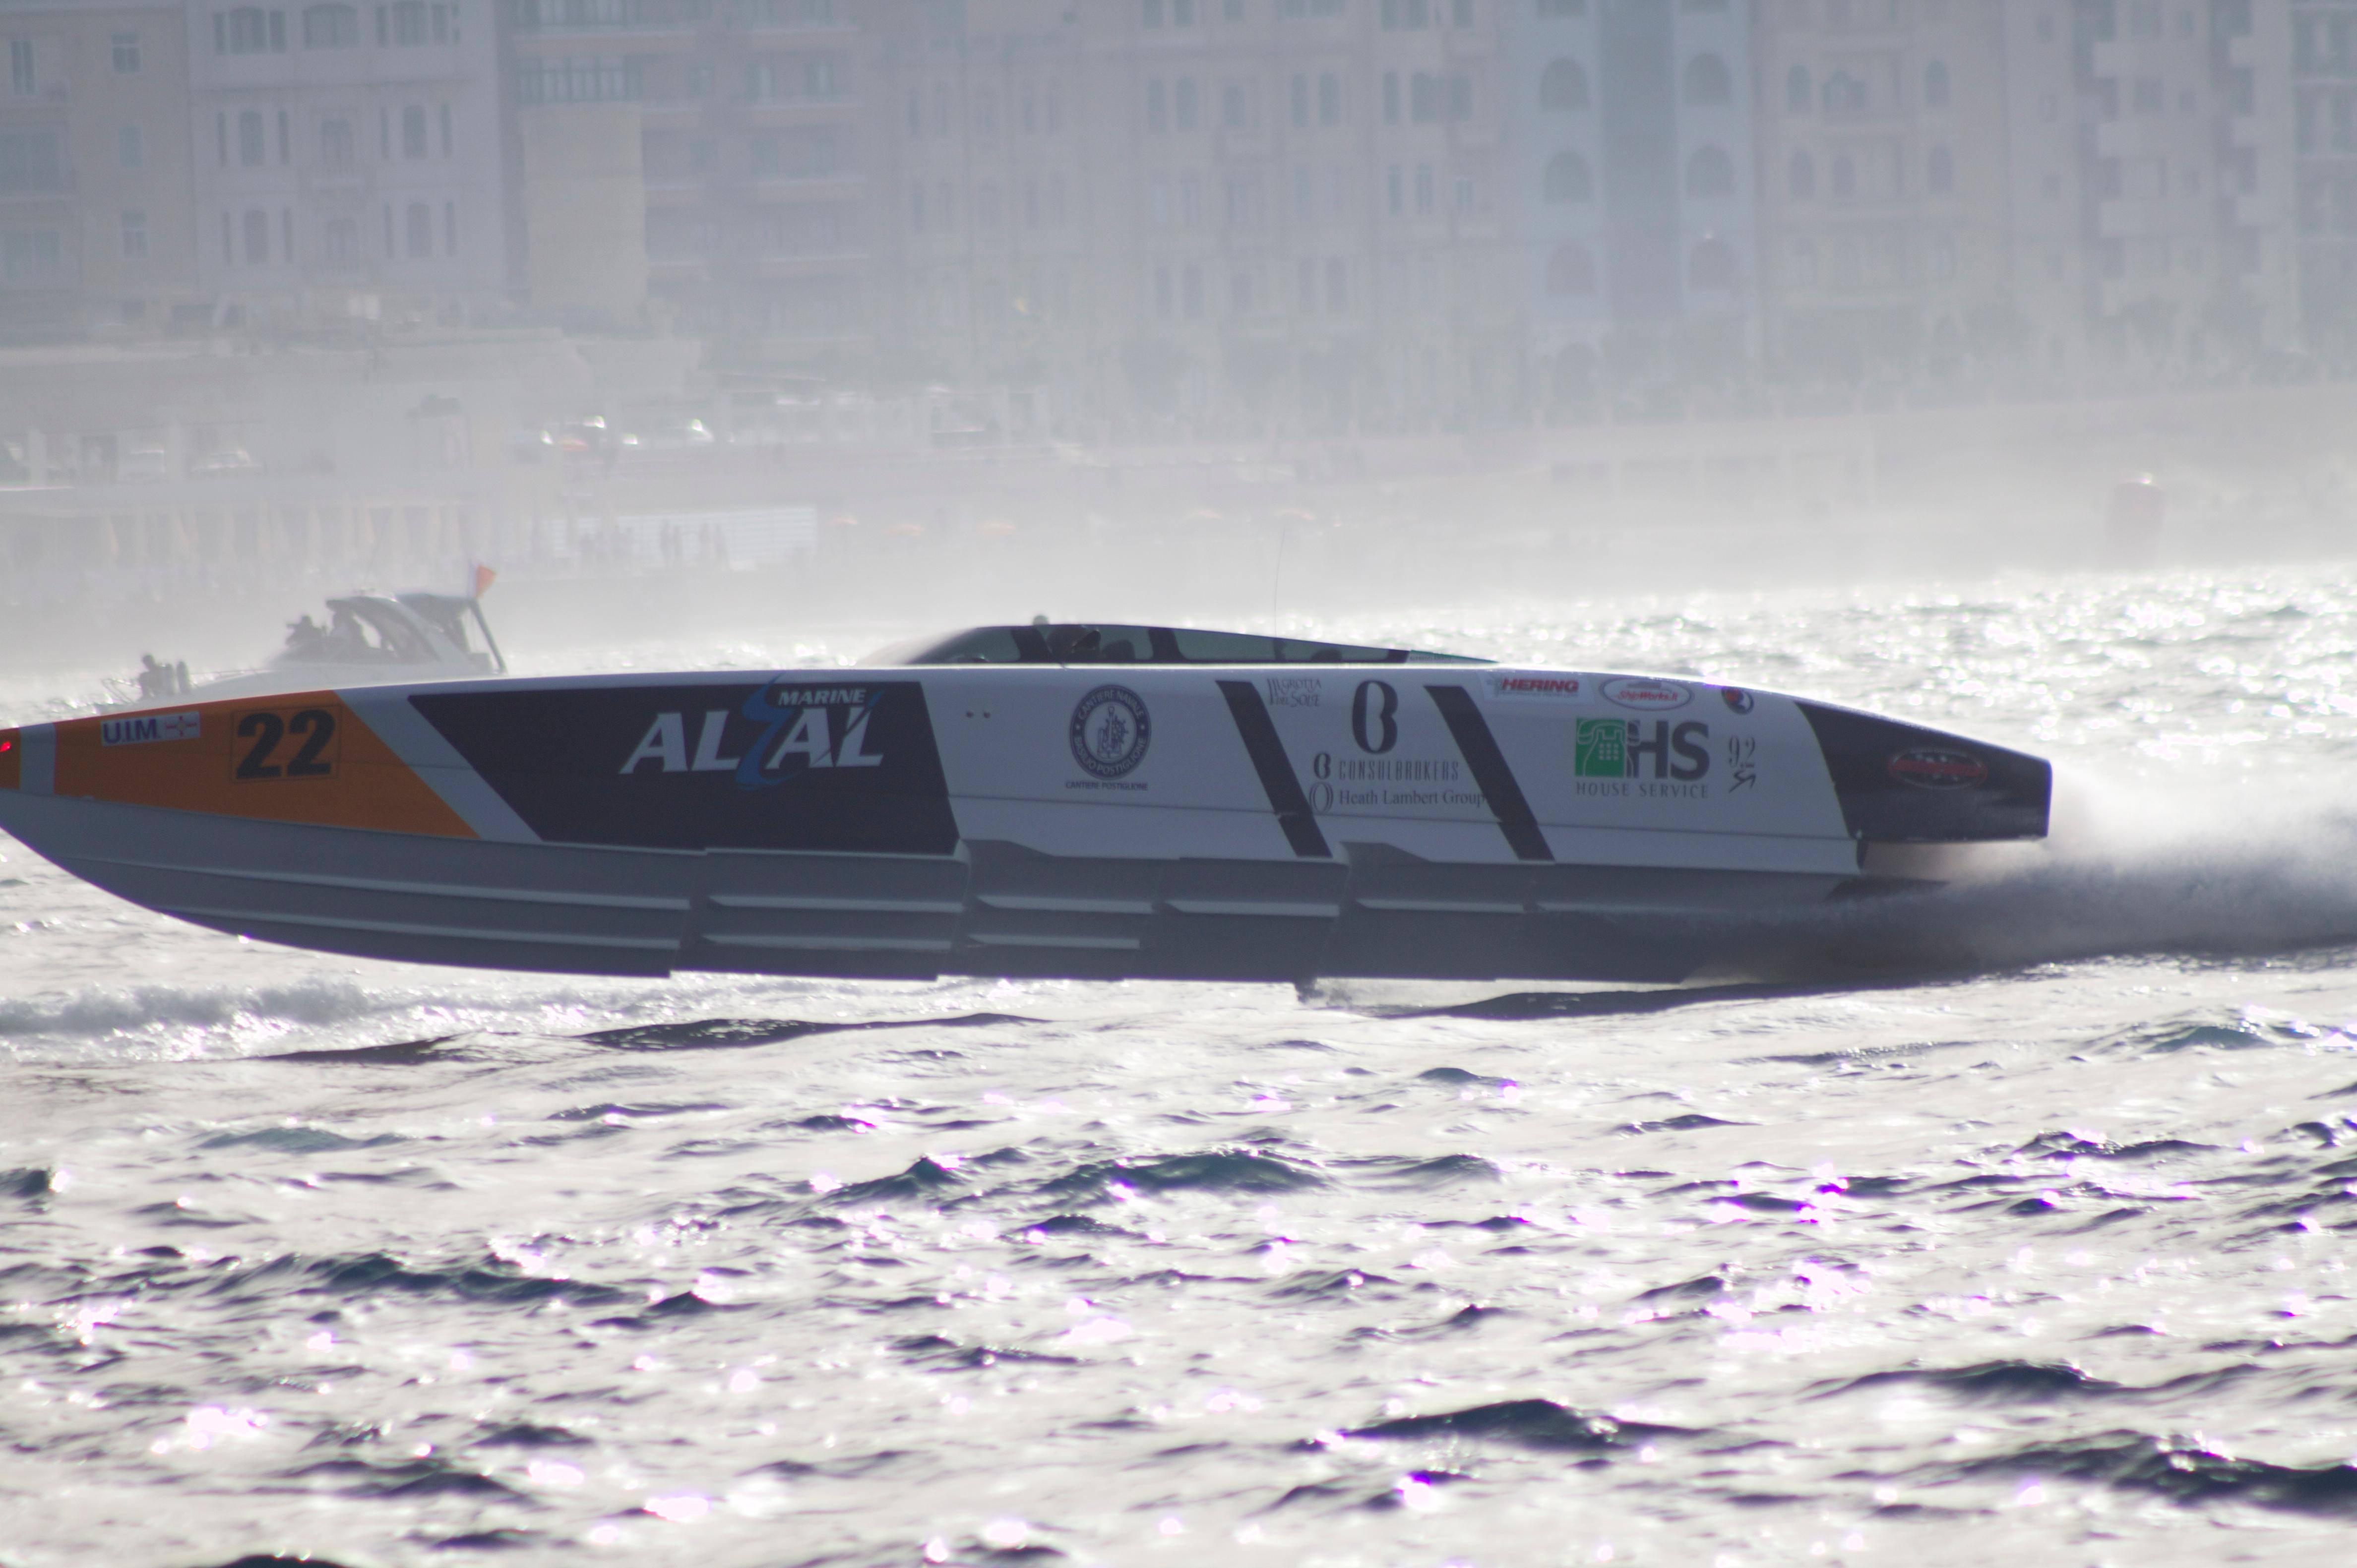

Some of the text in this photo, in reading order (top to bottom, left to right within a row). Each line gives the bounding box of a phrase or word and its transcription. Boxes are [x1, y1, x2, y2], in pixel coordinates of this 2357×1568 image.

[1502, 677, 1579, 692] HERING
[778, 688, 867, 705] MARINE
[1078, 689, 1145, 720] CANTIERE NAVALE
[236, 709, 336, 779] 22
[1626, 720, 1710, 781] HS
[1097, 738, 1146, 775] POSTIGLIONE
[1339, 760, 1459, 782] CONSULBROKERS
[1066, 781, 1148, 791] CANTIERE POSTIGLIONE
[1576, 782, 1709, 799] HOUSE SERVICE
[1339, 789, 1486, 808] Heath Lambert Group
